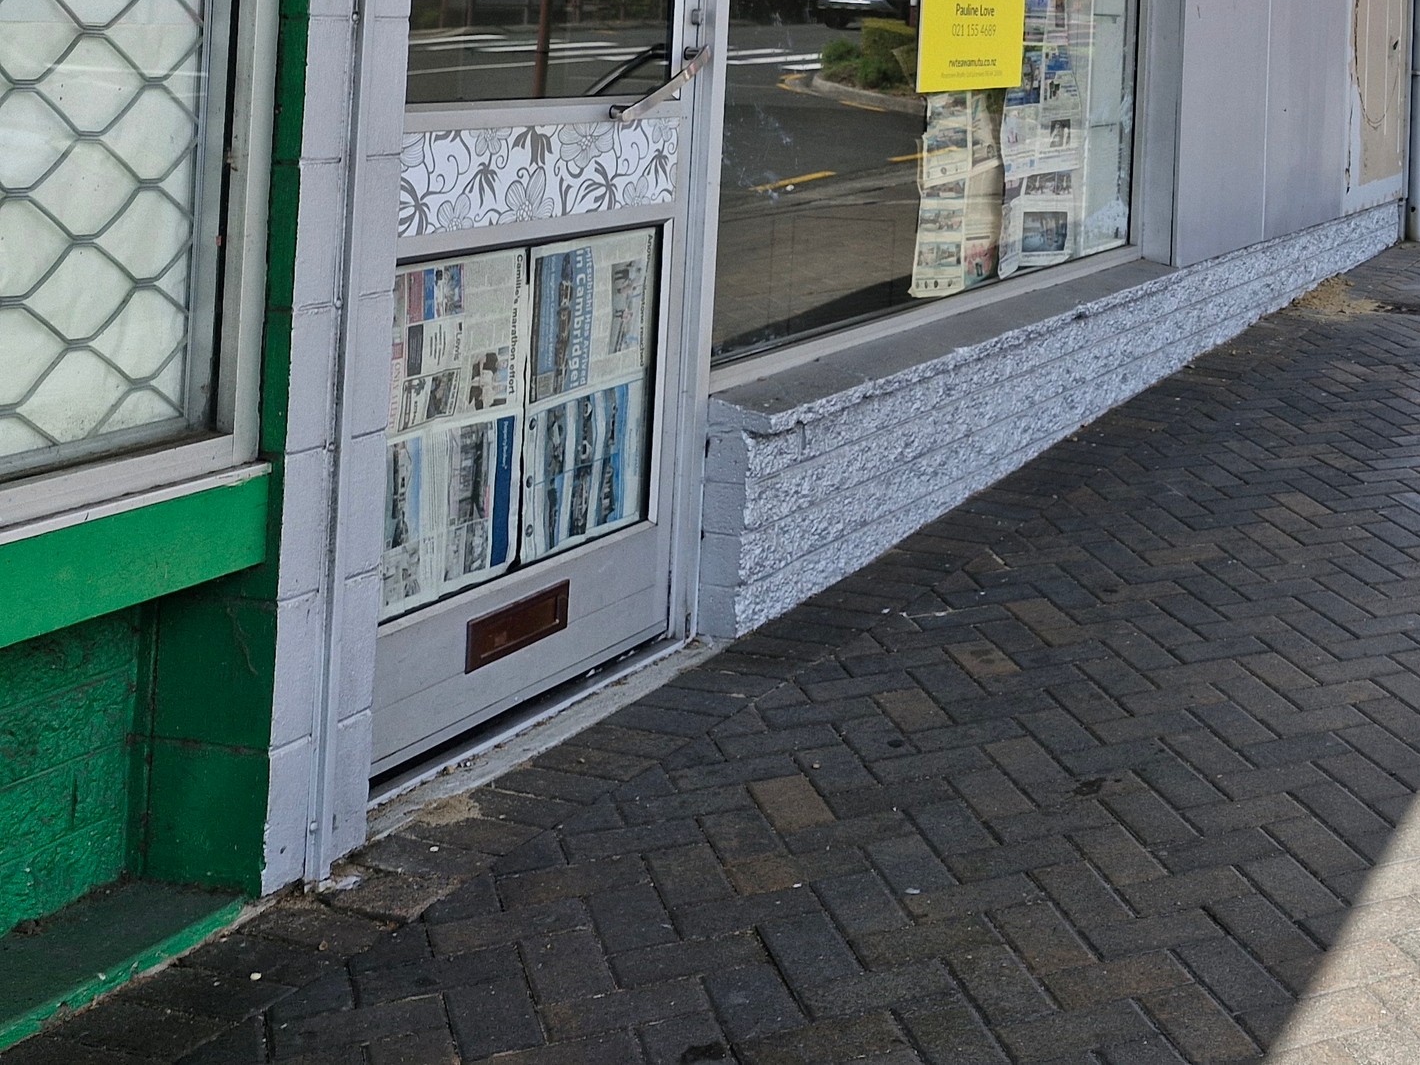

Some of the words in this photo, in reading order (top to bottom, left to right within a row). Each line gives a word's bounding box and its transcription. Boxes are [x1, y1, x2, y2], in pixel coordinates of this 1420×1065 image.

[952, 23, 964, 37] 021
[967, 23, 979, 37] 155
[956, 3, 979, 16] Pauline
[980, 4, 995, 17] Love
[513, 254, 524, 305] Camille's
[584, 247, 593, 312] Mitsubishi
[509, 307, 518, 361] marathon
[569, 274, 586, 389] Cambridge!
[583, 314, 591, 337] Has
[507, 364, 516, 395] effort
[579, 339, 590, 385] Arrived
